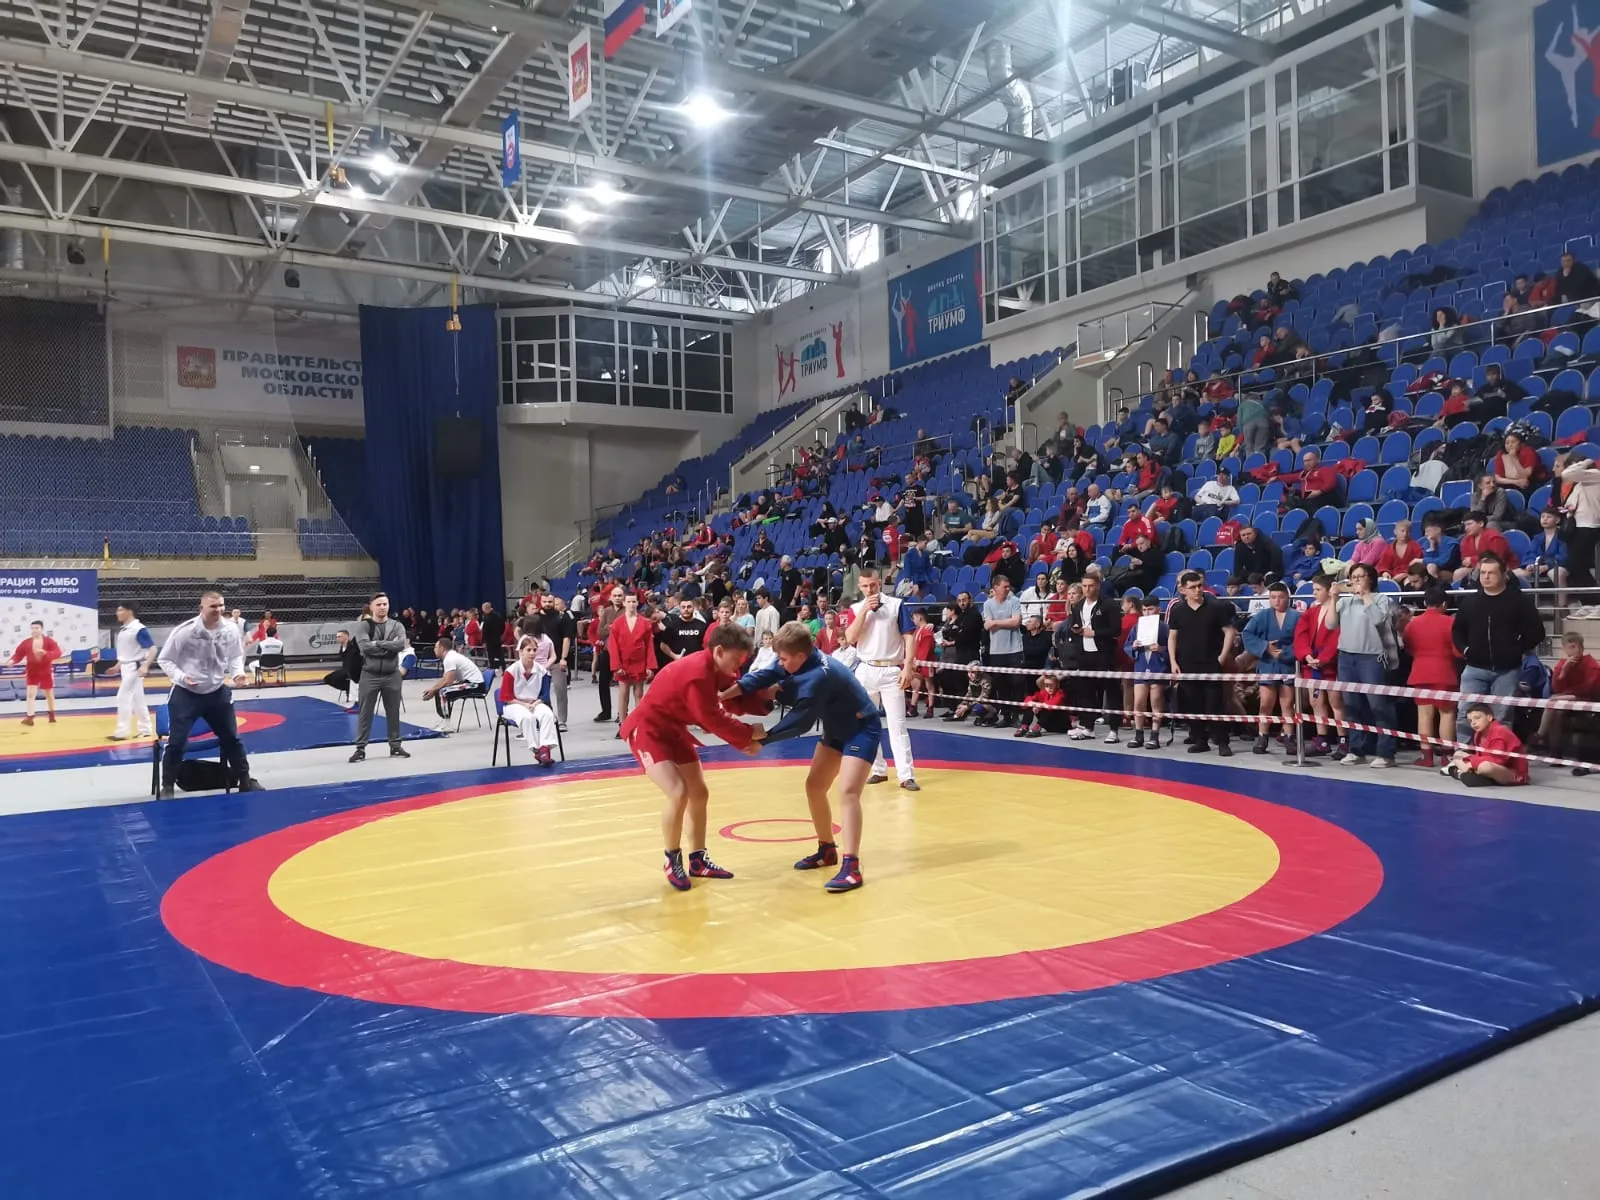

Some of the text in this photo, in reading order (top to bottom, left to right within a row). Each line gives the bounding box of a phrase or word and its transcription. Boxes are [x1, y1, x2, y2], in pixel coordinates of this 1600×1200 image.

[928, 308, 966, 335] ТРИУМФ
[241, 366, 364, 386] МОСКОВСКО
[800, 357, 828, 377] ТРИУМФ
[263, 382, 354, 400] ОБЛАСТИ
[40, 577, 79, 586] САМБО
